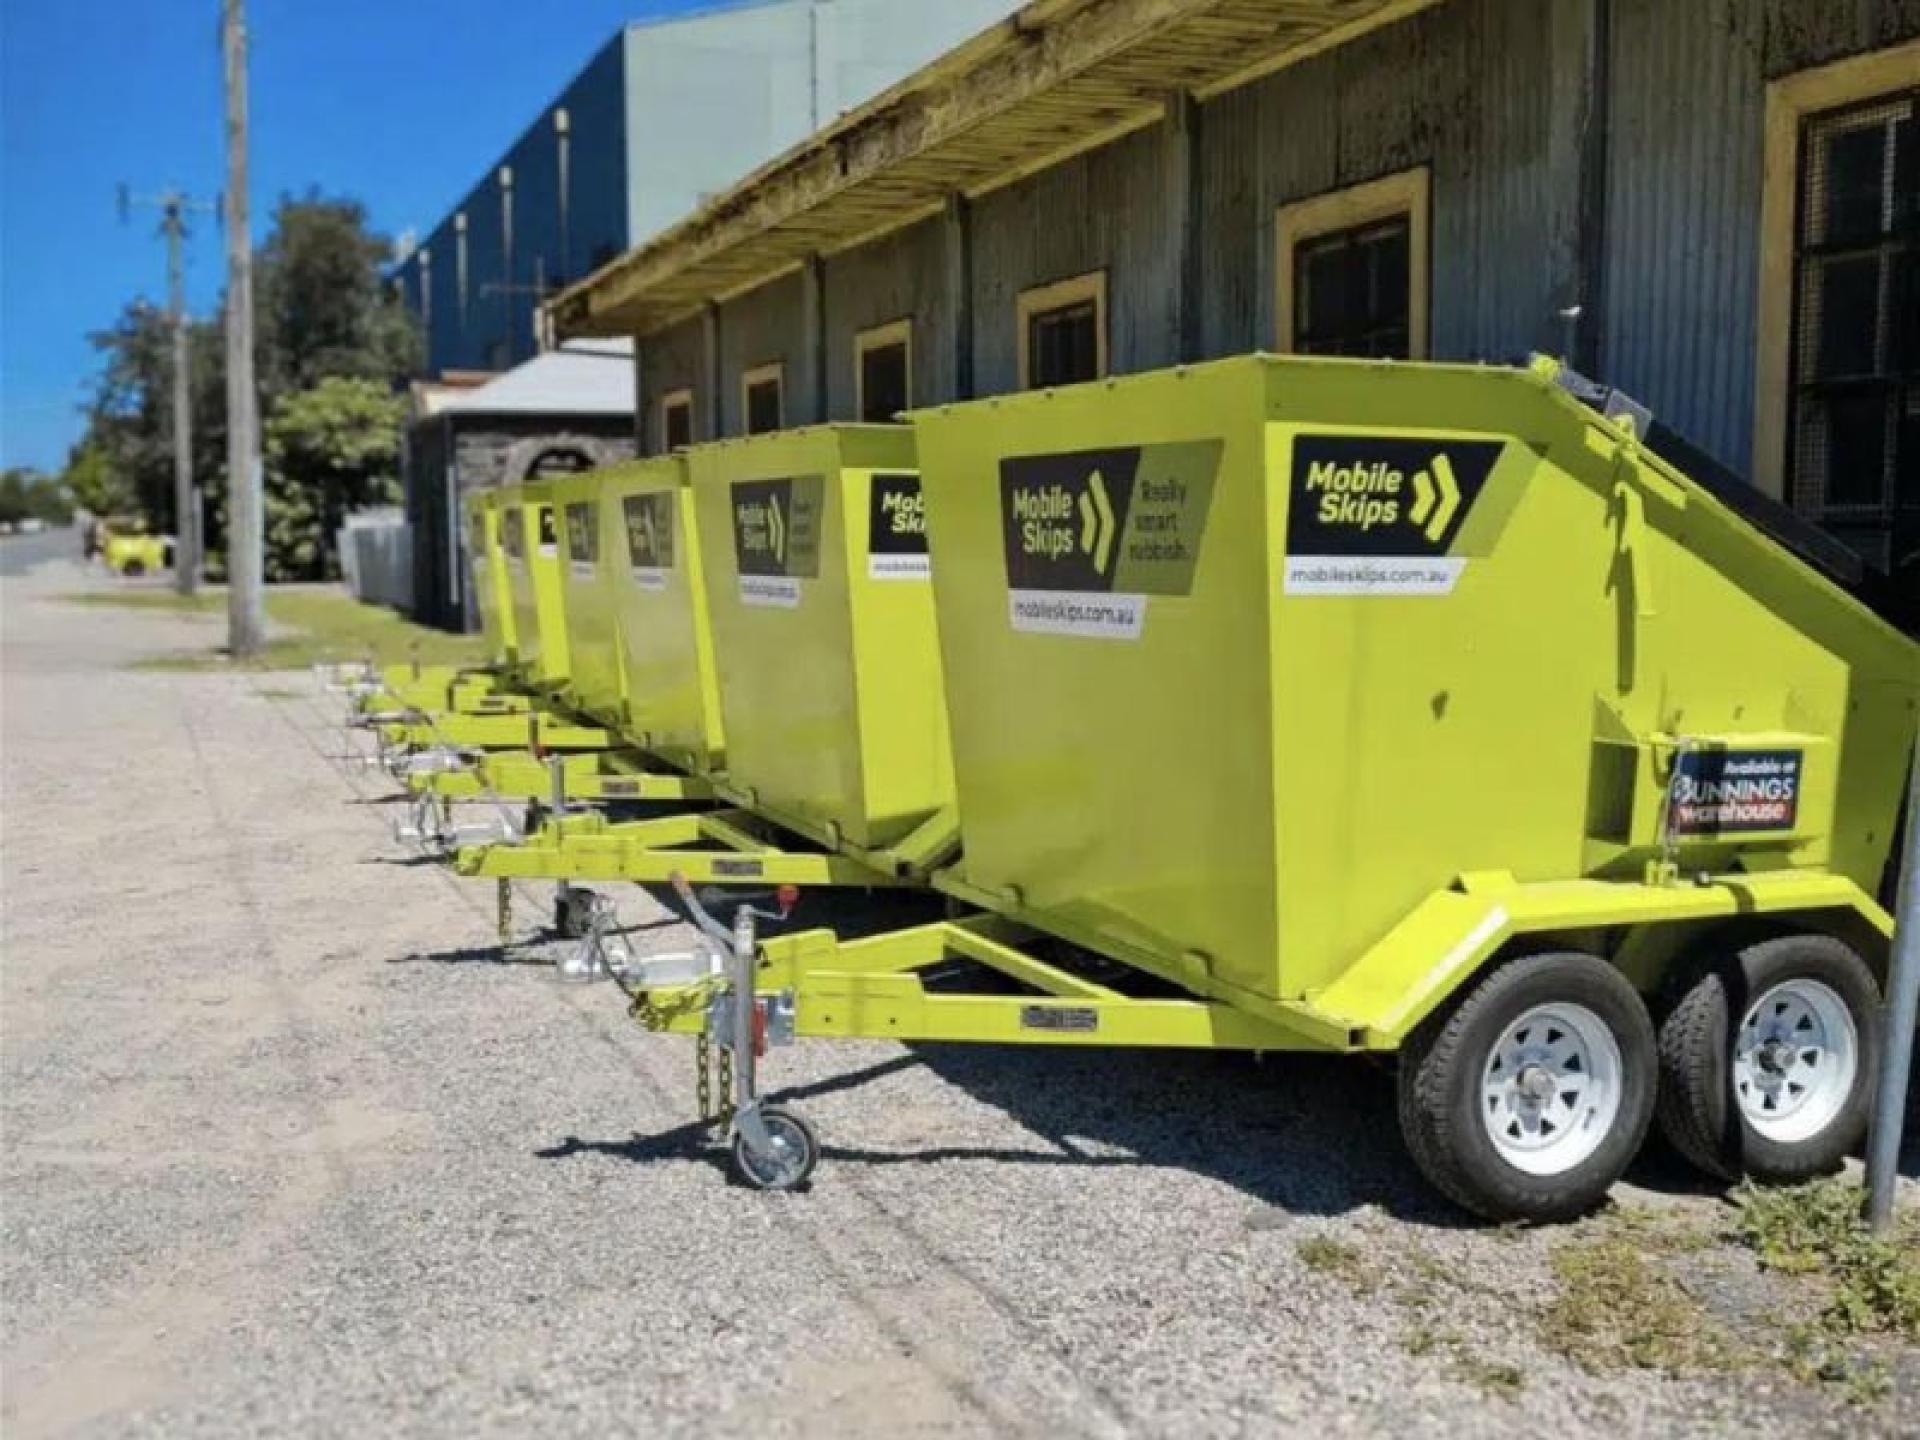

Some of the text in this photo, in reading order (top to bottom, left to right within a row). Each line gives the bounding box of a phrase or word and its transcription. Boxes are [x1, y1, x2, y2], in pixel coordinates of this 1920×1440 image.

[1305, 460, 1404, 492] Mobile
[881, 490, 924, 513] Mob
[1012, 484, 1074, 520] Mobile
[1142, 478, 1187, 507] Really
[1135, 510, 1177, 533] smart
[1318, 492, 1400, 531] Skips
[1021, 519, 1074, 561] Skips
[1291, 564, 1449, 588] mobileskips.com.au
[1015, 599, 1135, 626] mobileskips.com.au
[1679, 799, 1786, 823] warehouse
